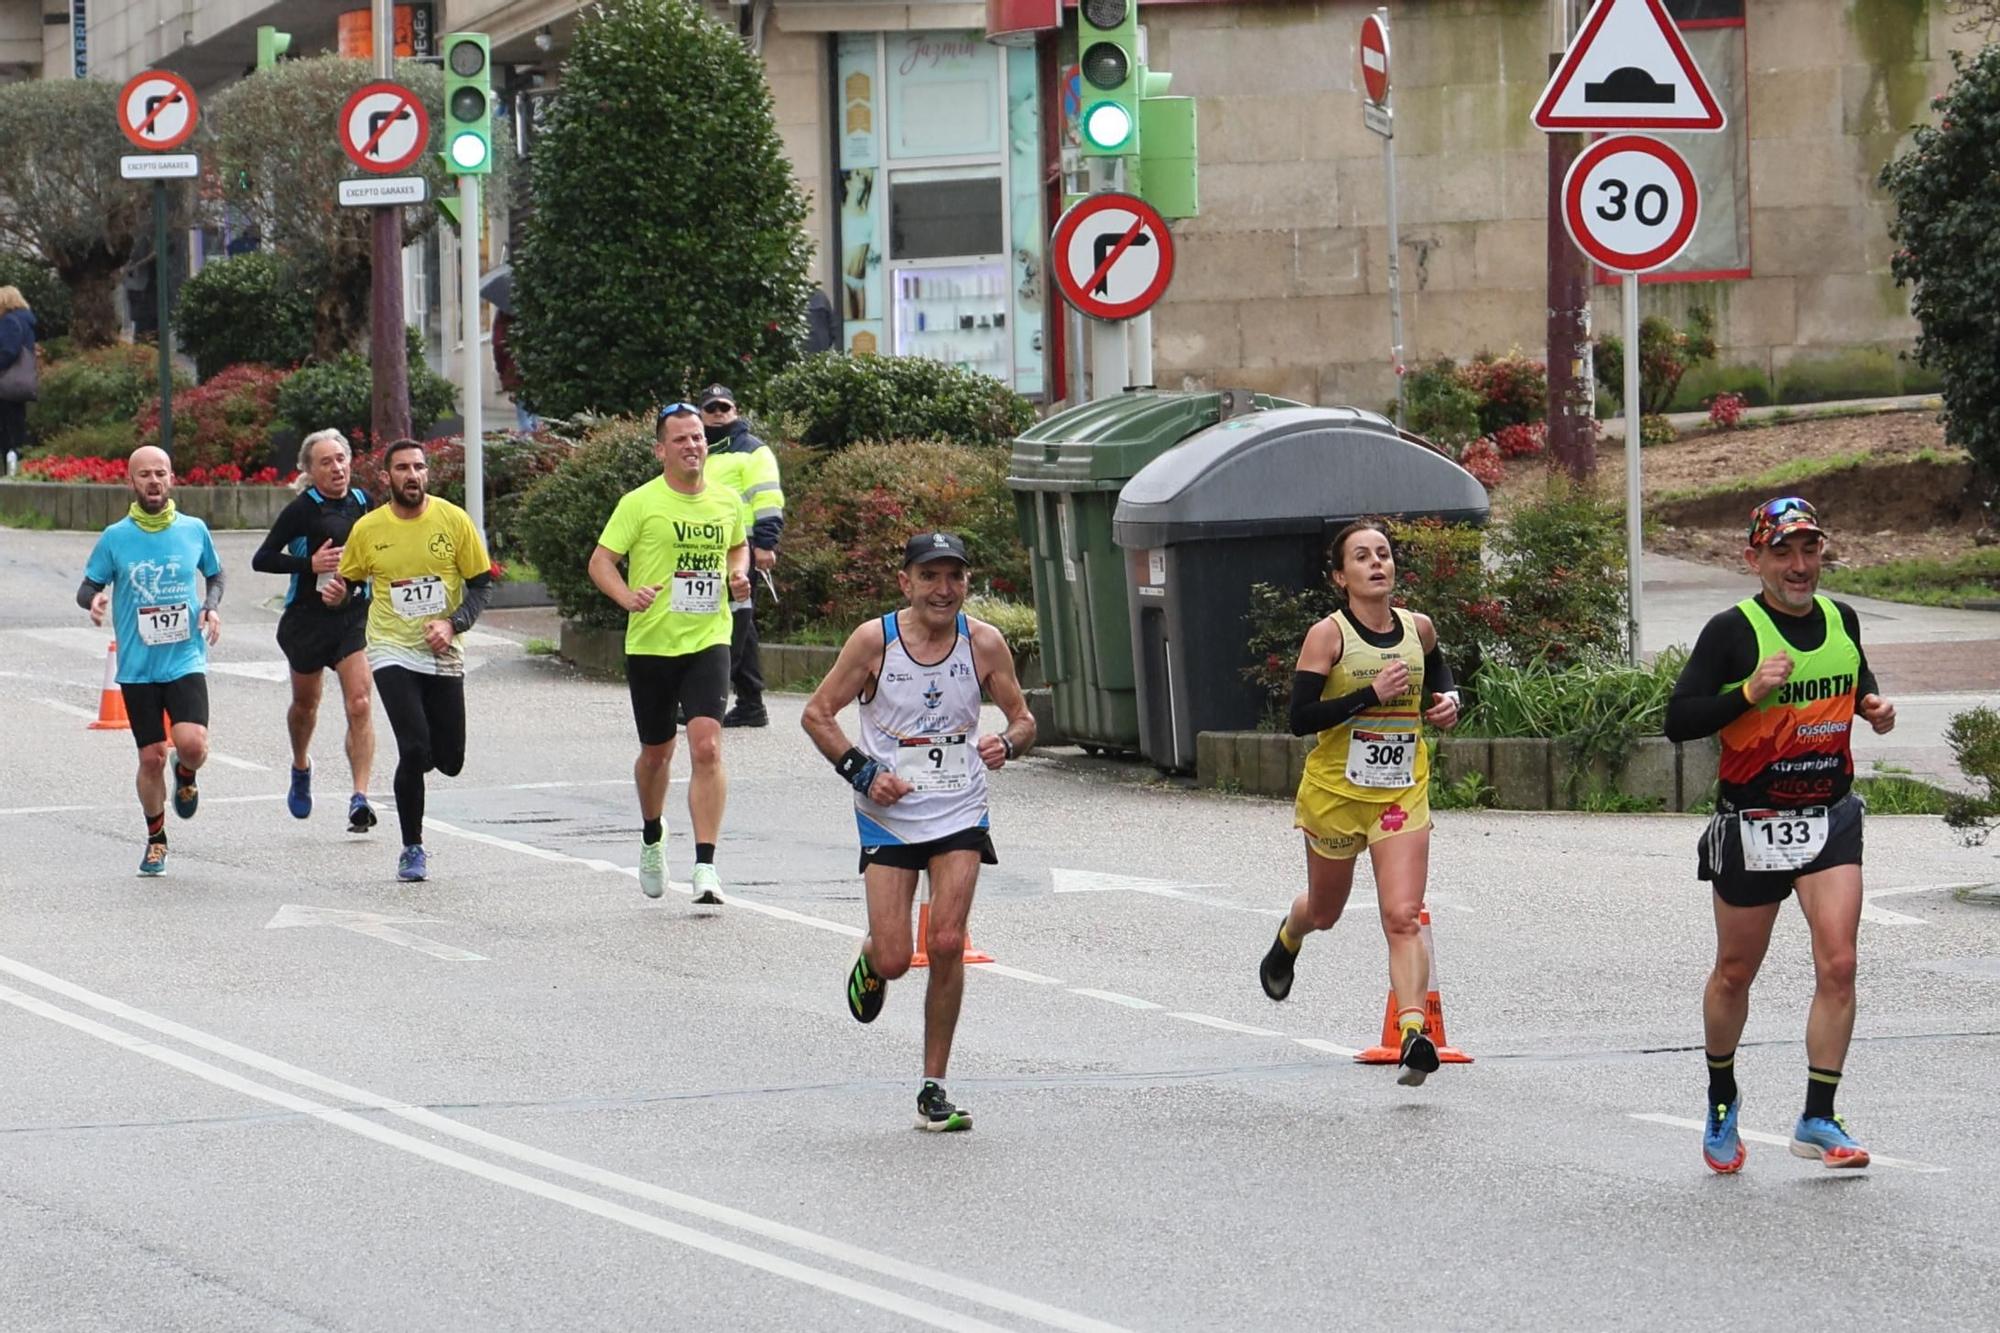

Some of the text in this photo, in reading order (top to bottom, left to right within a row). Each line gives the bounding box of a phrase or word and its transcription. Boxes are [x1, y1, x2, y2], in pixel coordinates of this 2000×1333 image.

[346, 187, 379, 197] EXCEPTO
[1596, 178, 1669, 227] 30
[402, 584, 433, 602] 217
[685, 580, 713, 597] 191
[150, 612, 179, 629] 197
[1778, 673, 1853, 704] 3NORTH
[928, 747, 944, 769] 9
[1364, 743, 1405, 766] 308
[1761, 820, 1811, 846] 133
